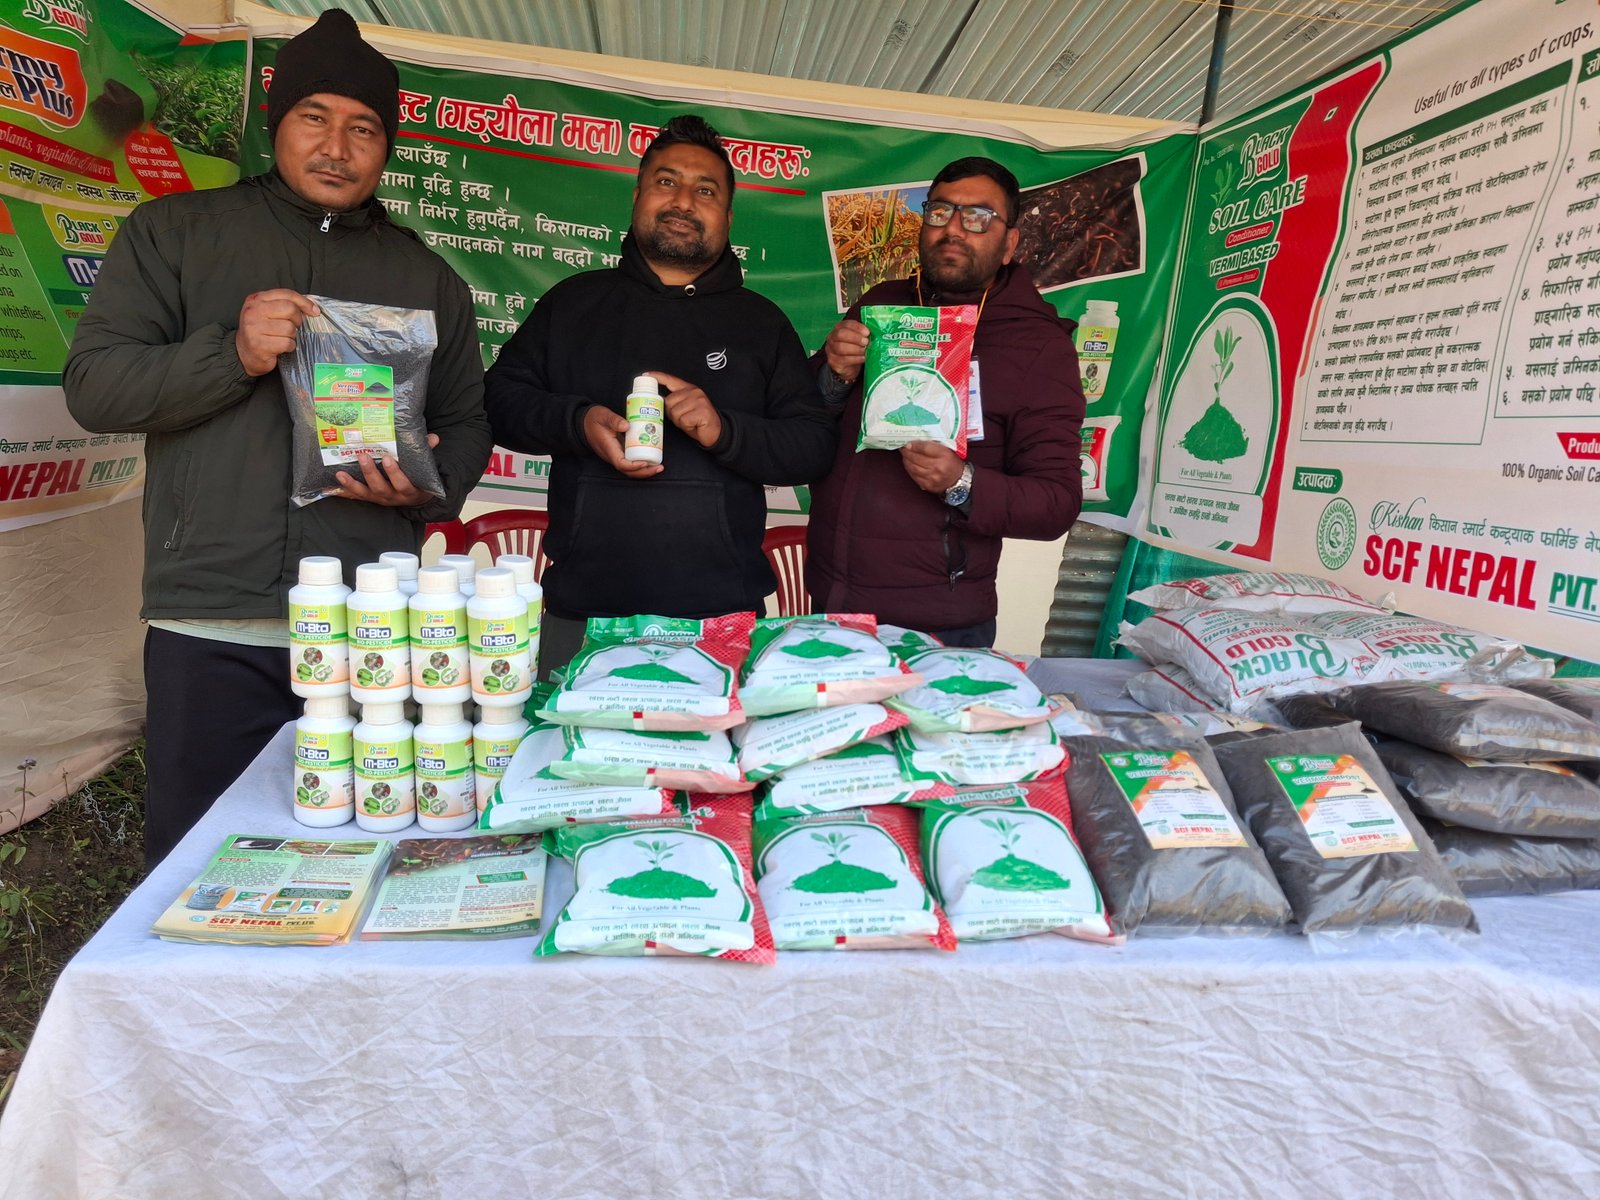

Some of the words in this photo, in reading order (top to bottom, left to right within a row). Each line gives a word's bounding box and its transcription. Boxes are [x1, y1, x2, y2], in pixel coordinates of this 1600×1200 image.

[52, 8, 87, 37] GOLD
[0, 46, 64, 91] rmy
[1414, 88, 1451, 115] Useful
[1451, 80, 1468, 99] for
[1470, 71, 1486, 90] all
[1488, 52, 1525, 82] types
[1529, 39, 1547, 63] of
[1548, 22, 1594, 55] crops,
[12, 70, 73, 119] Plus
[561, 113, 622, 156] मल)
[1238, 125, 1292, 190] BLACK
[1257, 149, 1280, 174] GOLD
[380, 171, 415, 190] तामा
[421, 172, 452, 197] वृद्धि
[460, 180, 493, 202] हुन्छ
[1209, 199, 1250, 234] SOIL
[1253, 175, 1308, 220] CARE
[56, 213, 101, 245] BLACK
[418, 198, 459, 225] निर्भर
[466, 206, 524, 234] हुनुपर्दैन,
[535, 212, 612, 243] किसानको
[1228, 225, 1271, 244] Conditioner
[1577, 224, 1593, 241] PH
[80, 232, 105, 245] GOLD
[424, 230, 505, 255] उत्पादनको
[512, 242, 544, 260] माग
[10, 269, 22, 279] on
[1210, 256, 1240, 277] VERMI
[1240, 242, 1280, 269] BASED
[2, 306, 46, 322] whiteflies,
[505, 291, 526, 314] हुने
[476, 317, 519, 334] नाउने
[1525, 356, 1559, 378] यसलाई
[1521, 386, 1547, 404] यसको
[32, 436, 54, 452] स्मार्ट
[1568, 438, 1600, 455] Produ
[0, 459, 86, 502] NEPAL
[88, 461, 112, 482] PVT.
[1502, 463, 1525, 478] 100%
[1528, 465, 1563, 483] Organic
[1566, 466, 1585, 482] Soil
[1587, 468, 1600, 482] Ca
[1369, 497, 1426, 536] Kishan
[1428, 513, 1458, 534] किसान
[1462, 518, 1487, 536] स्मार्ट
[1540, 527, 1579, 549] फार्मिङ
[1585, 531, 1600, 552] नेप
[1364, 534, 1422, 584] SCF
[1425, 544, 1537, 610] NEPAL
[1549, 571, 1598, 612] PVT.
[1226, 635, 1293, 659] GOLD
[1230, 633, 1348, 681] BLACK
[240, 918, 283, 926] NEPAL
